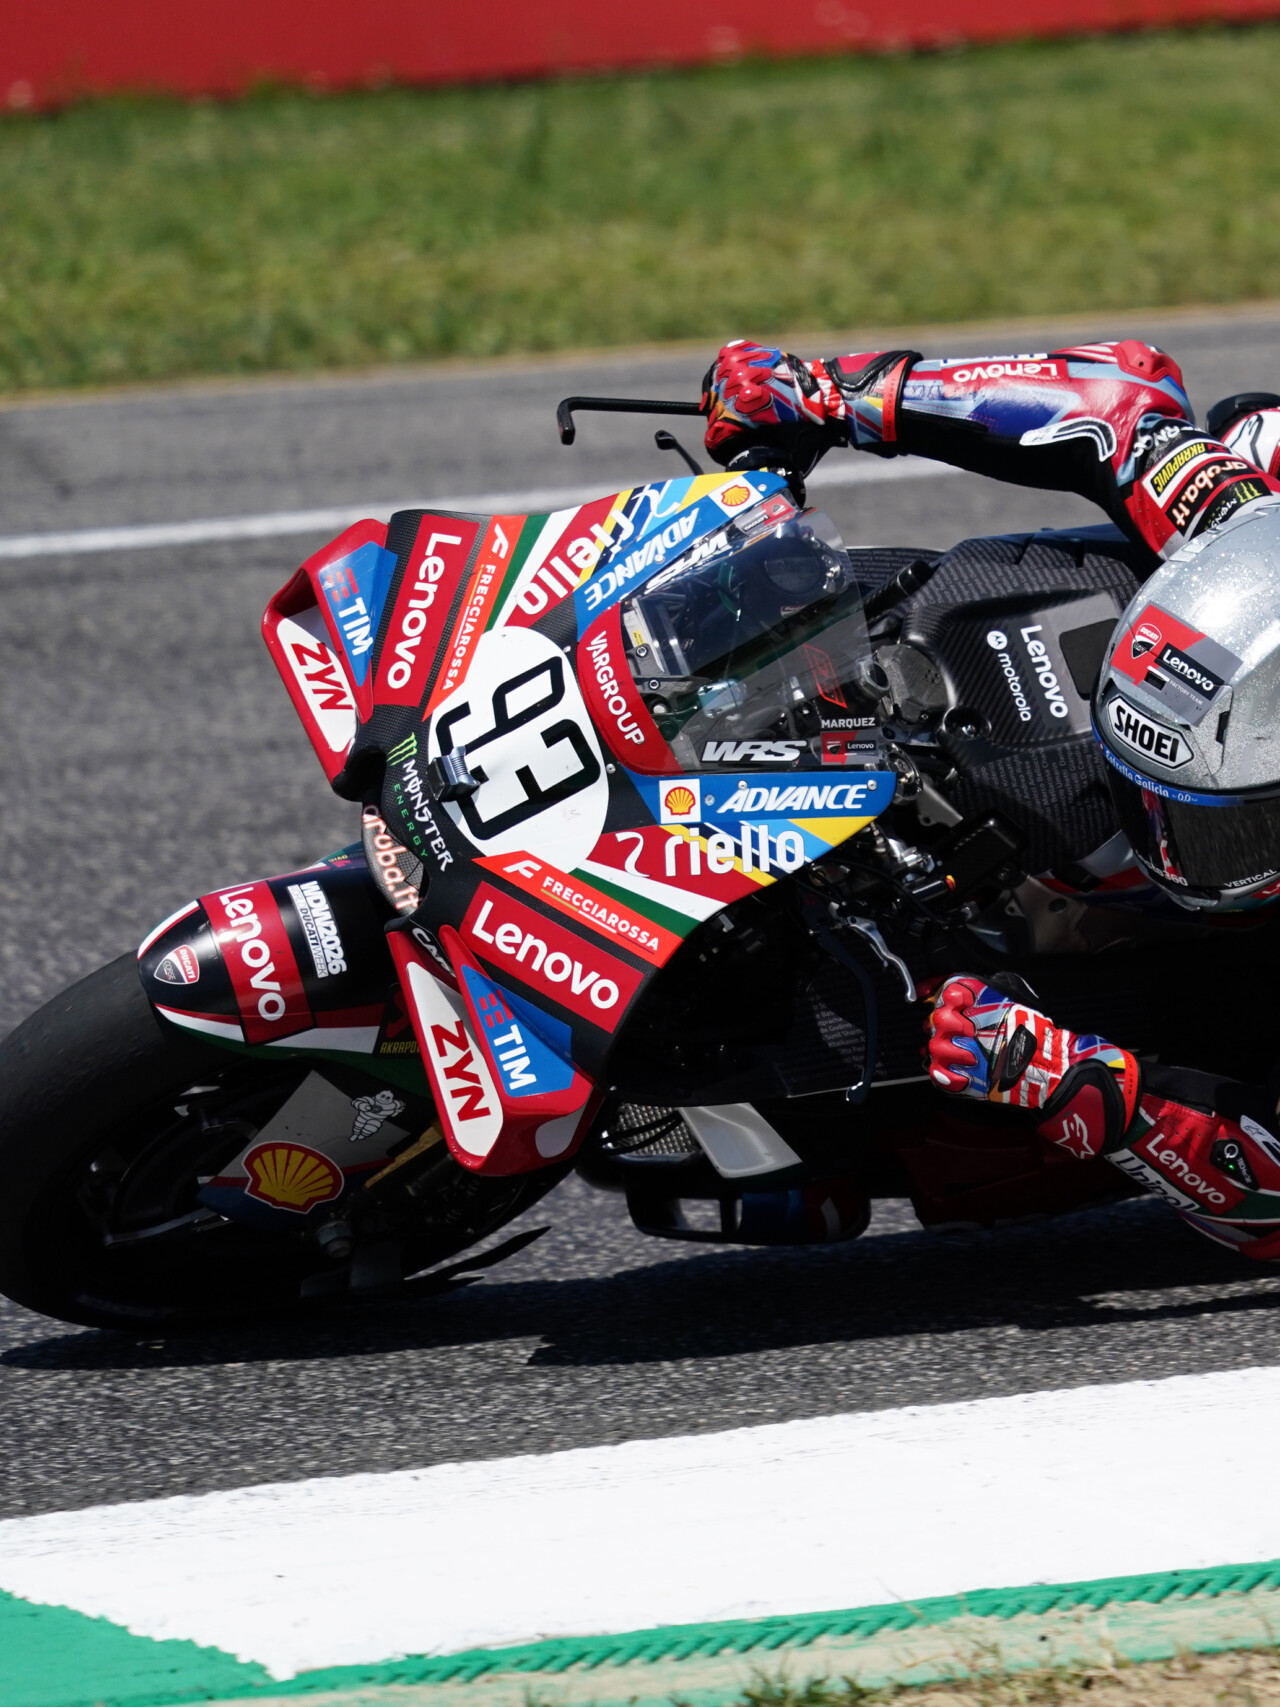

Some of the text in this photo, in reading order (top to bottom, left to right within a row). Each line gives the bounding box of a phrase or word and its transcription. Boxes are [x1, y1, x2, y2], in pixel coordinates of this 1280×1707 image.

[953, 363, 1057, 383] Lenovo
[1153, 442, 1206, 493] AKRAPOVIC
[1171, 460, 1249, 527] aruba.it
[515, 508, 635, 615] riello
[584, 507, 700, 611] ADVANCE
[338, 597, 374, 656] TIM
[387, 532, 462, 689] Lenovo
[442, 563, 496, 690] FRECCIAROSSA
[1140, 627, 1159, 641] DUCATI
[290, 642, 354, 710] ZYN
[586, 630, 645, 746] VARGROUP
[997, 652, 1032, 723] motorola
[1020, 624, 1068, 720] Lenovo
[1162, 649, 1214, 691] Lenovo
[1170, 680, 1204, 705] FACTORY TEAM
[435, 655, 601, 841] 93
[701, 740, 807, 762] WRS
[821, 717, 876, 728] MARQUEZ
[1114, 704, 1180, 762] SHOEI
[716, 784, 868, 814] ADVANCE
[1105, 750, 1134, 781] Estrella
[1134, 774, 1169, 798] Galicia
[394, 783, 428, 857] ENERGY
[402, 758, 454, 873] MONSTER
[362, 805, 423, 911] aruba.it
[664, 824, 805, 877] riello
[1224, 869, 1277, 888] VERTICAL
[299, 880, 348, 976] WDW2026
[542, 875, 660, 952] FRECCIAROSSA
[179, 948, 197, 980] DUCATI
[219, 887, 286, 1021] Lenovo
[471, 899, 620, 1009] Lenovo
[379, 1041, 420, 1054] AKRAPO
[431, 1019, 492, 1122] ZYN
[493, 1024, 537, 1091] TIM
[1116, 1156, 1197, 1209] Unipol
[1146, 1133, 1226, 1204] Lenovo
